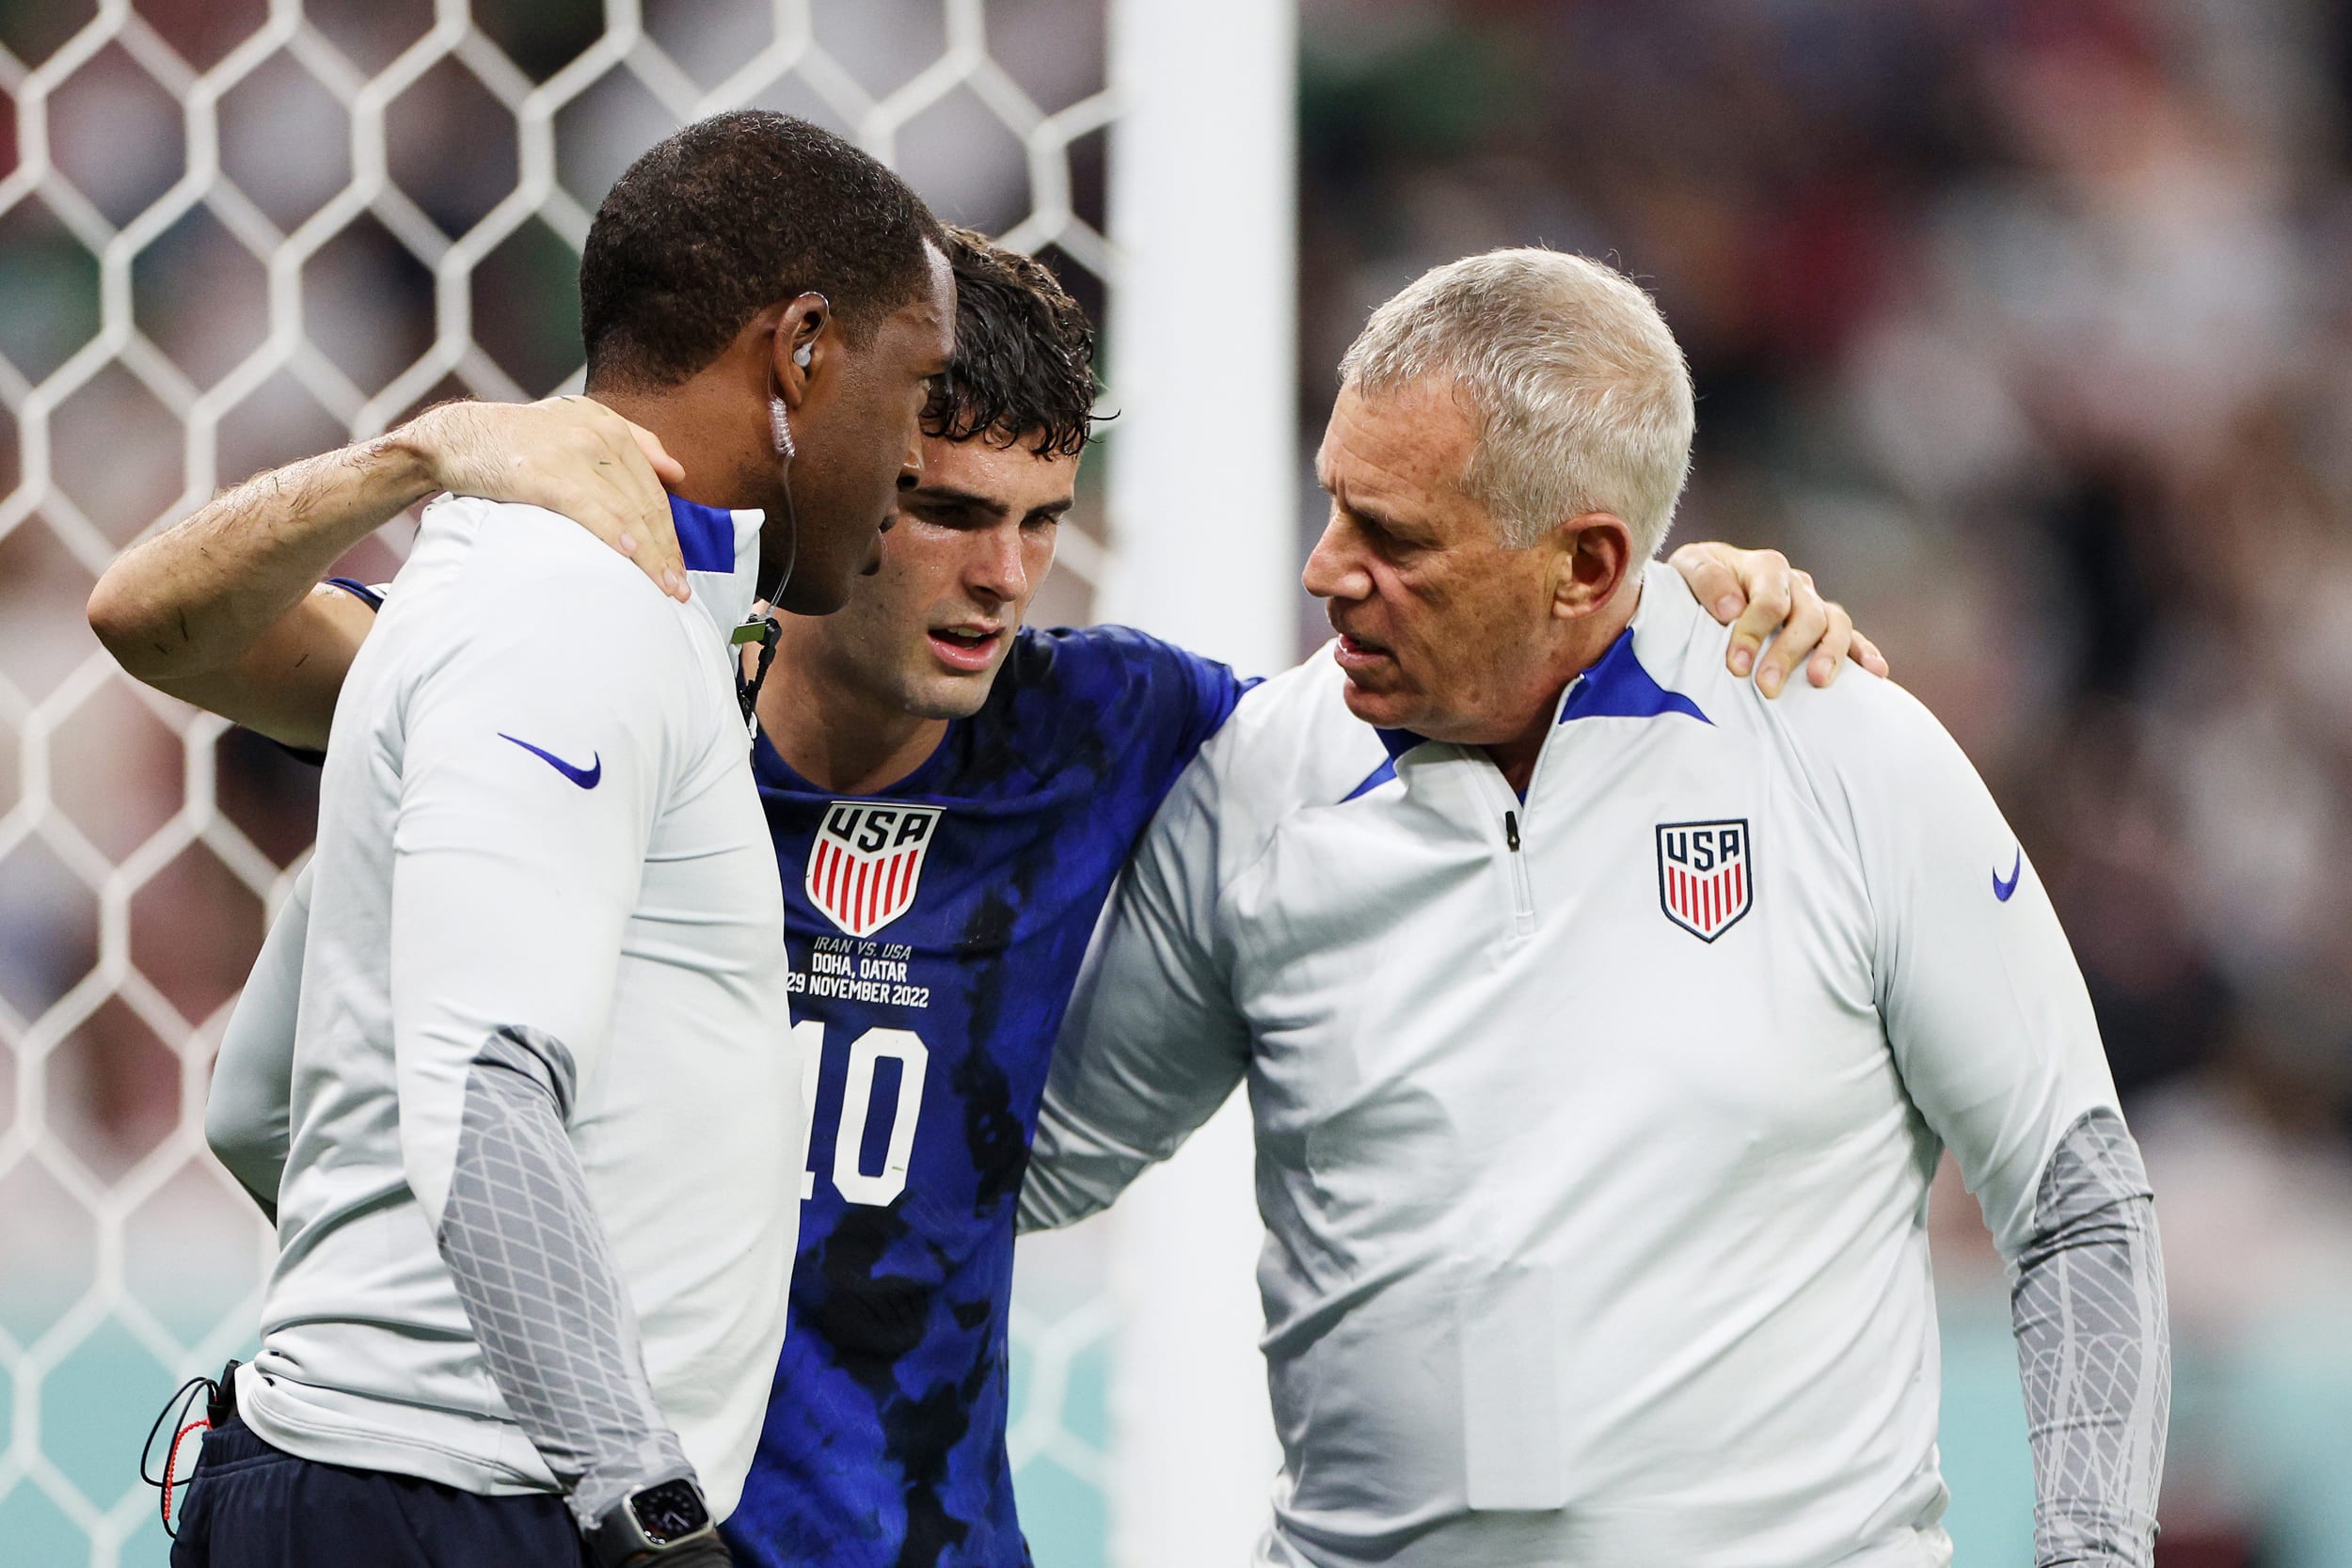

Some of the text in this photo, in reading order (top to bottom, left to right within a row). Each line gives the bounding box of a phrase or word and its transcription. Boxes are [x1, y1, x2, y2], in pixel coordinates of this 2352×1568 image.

[827, 807, 933, 854] USA
[1666, 830, 1740, 872] USA
[814, 936, 912, 960] IRAN VS. USA
[812, 952, 907, 983] DOHA, QATAR
[787, 972, 930, 1008] 29 NOVEMBER 2022
